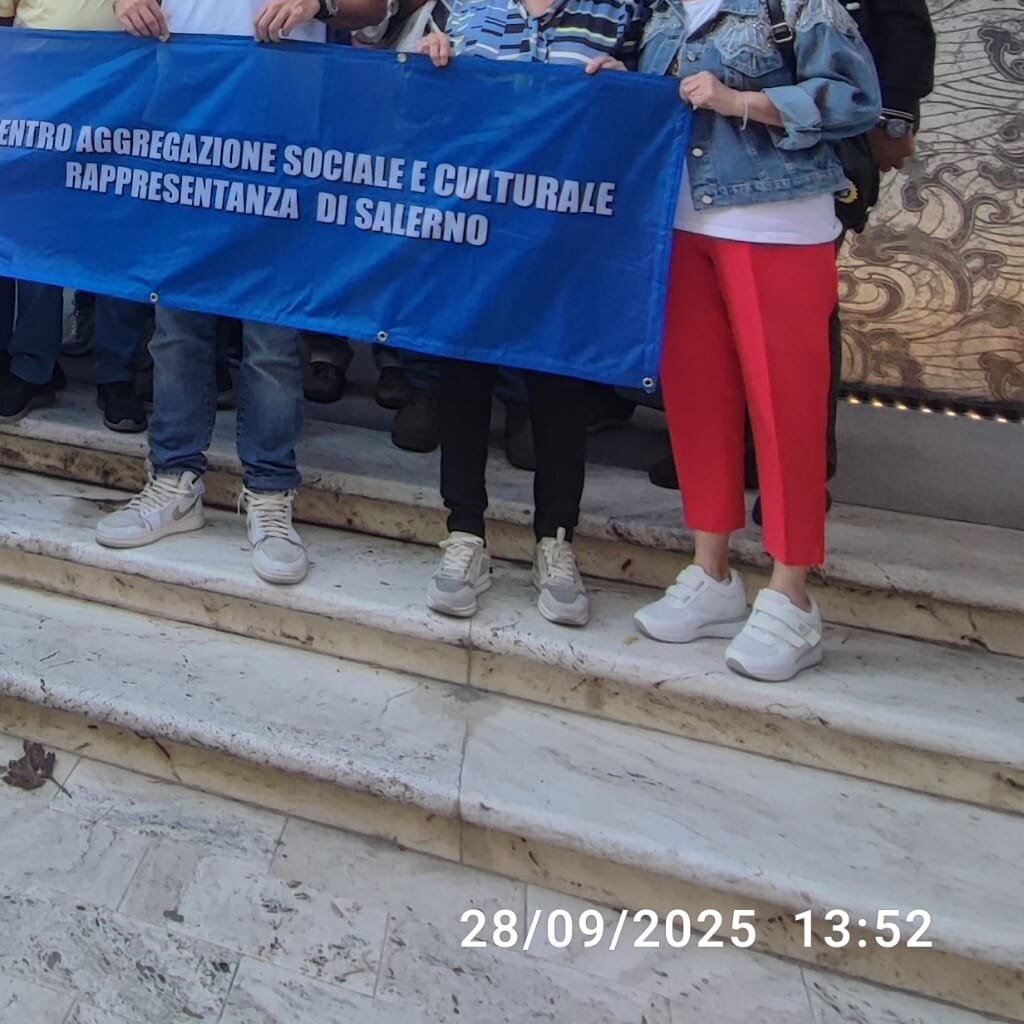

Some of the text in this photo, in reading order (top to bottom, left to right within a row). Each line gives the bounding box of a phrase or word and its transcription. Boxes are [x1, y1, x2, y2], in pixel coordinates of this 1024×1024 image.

[65, 161, 489, 246] RAPPRESENTANZA DI SALERNO
[76, 126, 277, 173] AGGREGAZIONE
[283, 144, 405, 189] SOCIALE
[410, 160, 428, 193] E
[433, 163, 616, 216] CULTURALE
